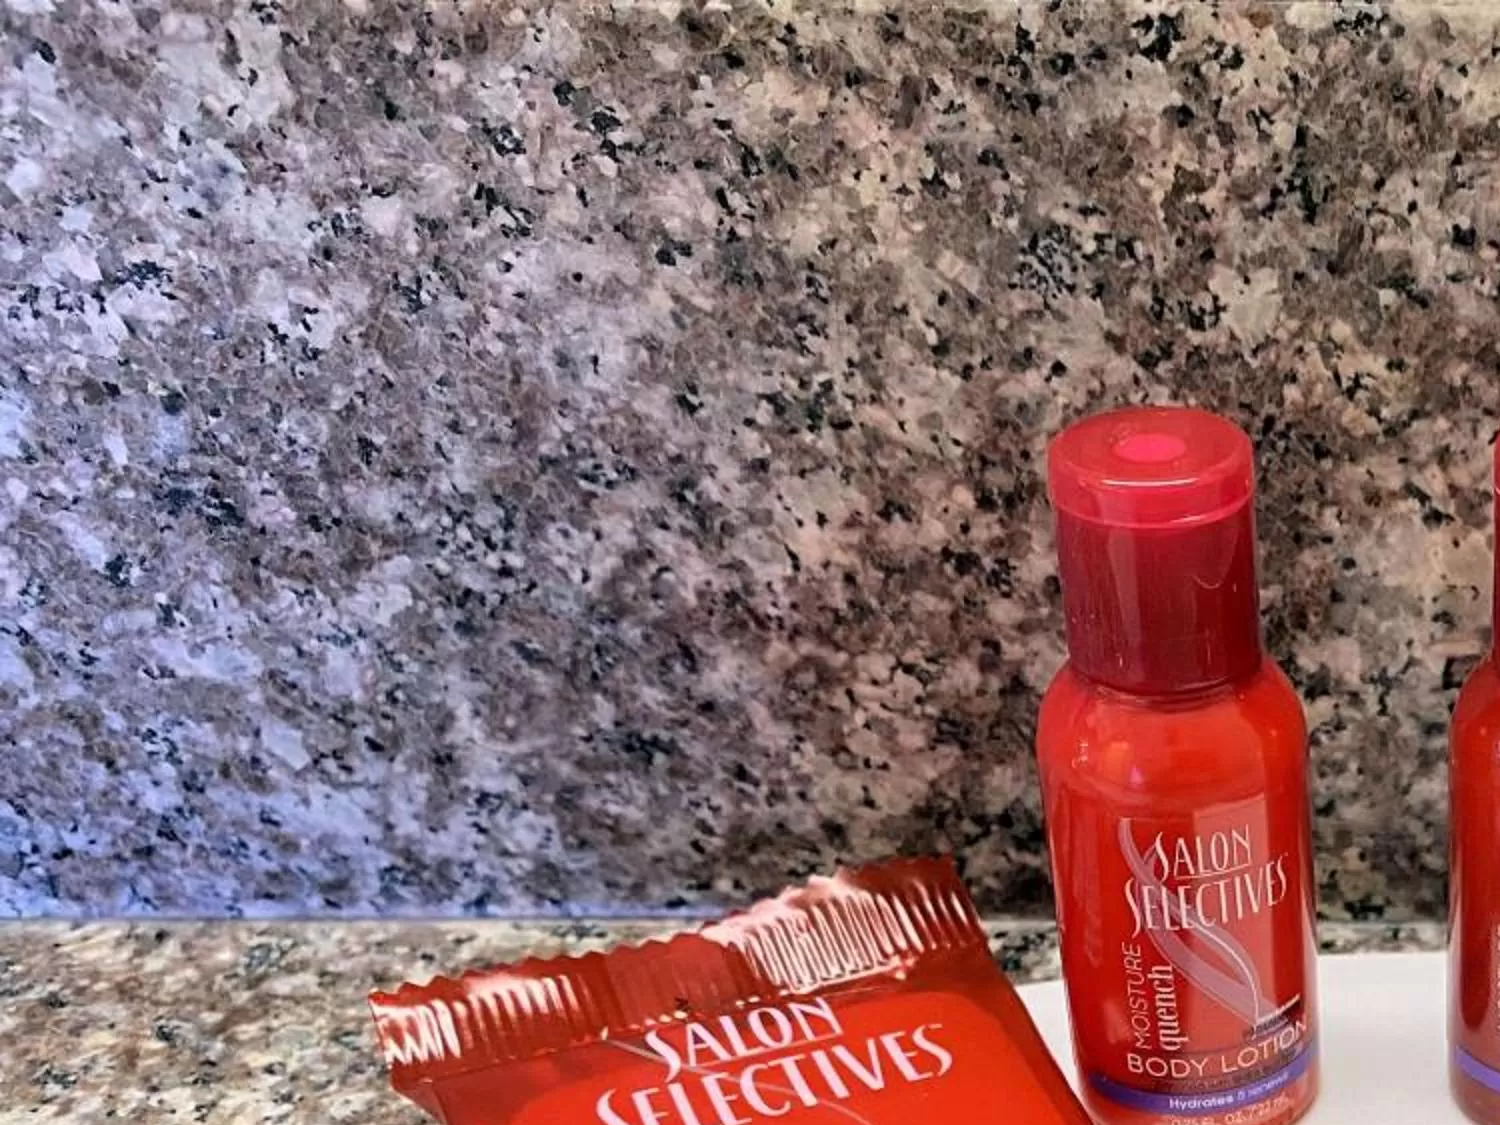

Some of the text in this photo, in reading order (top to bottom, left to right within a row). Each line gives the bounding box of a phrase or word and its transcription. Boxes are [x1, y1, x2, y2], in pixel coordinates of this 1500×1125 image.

[1153, 824, 1251, 882] SALON
[1125, 854, 1289, 937] SELECTIVES
[1122, 941, 1152, 1050] MOISTURE
[1148, 964, 1189, 1052] quench
[645, 997, 843, 1083] SALON
[1127, 1053, 1209, 1079] BODY
[1220, 1015, 1308, 1073] LOTION
[1169, 1094, 1234, 1110] Hydrates
